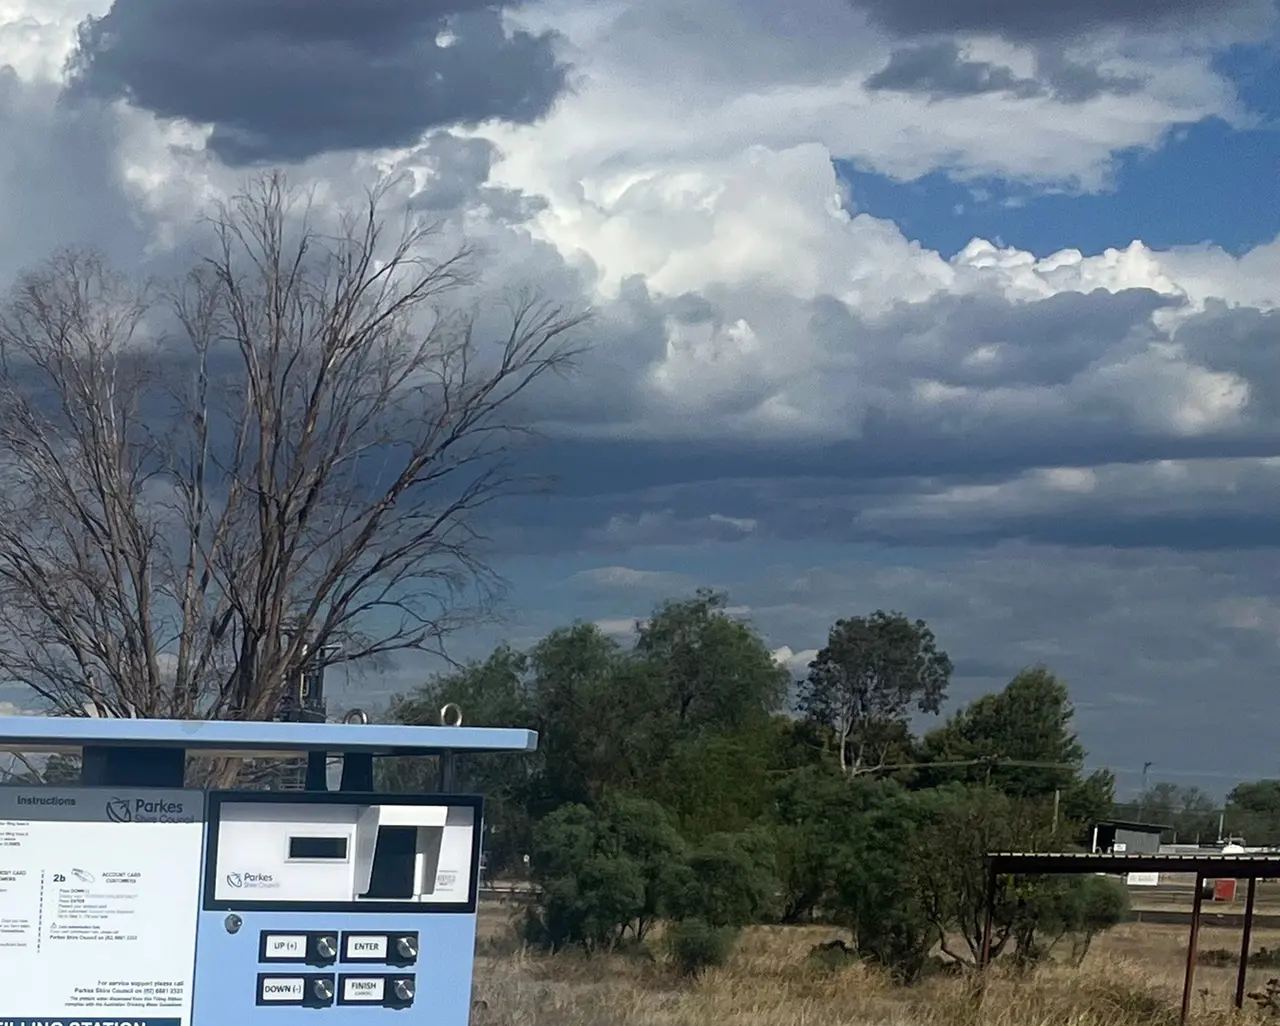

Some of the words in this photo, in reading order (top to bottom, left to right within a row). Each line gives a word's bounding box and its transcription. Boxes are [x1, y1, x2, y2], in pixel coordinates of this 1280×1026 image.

[16, 795, 76, 806] Instructions
[135, 798, 183, 813] Parkes
[134, 814, 158, 823] Shire
[159, 815, 195, 824] Council
[53, 874, 66, 882] 2b
[244, 872, 274, 882] Parkes
[274, 942, 286, 950] UP
[354, 942, 380, 951] ENTER
[265, 985, 291, 993] DOWN
[351, 981, 377, 990] FINISH
